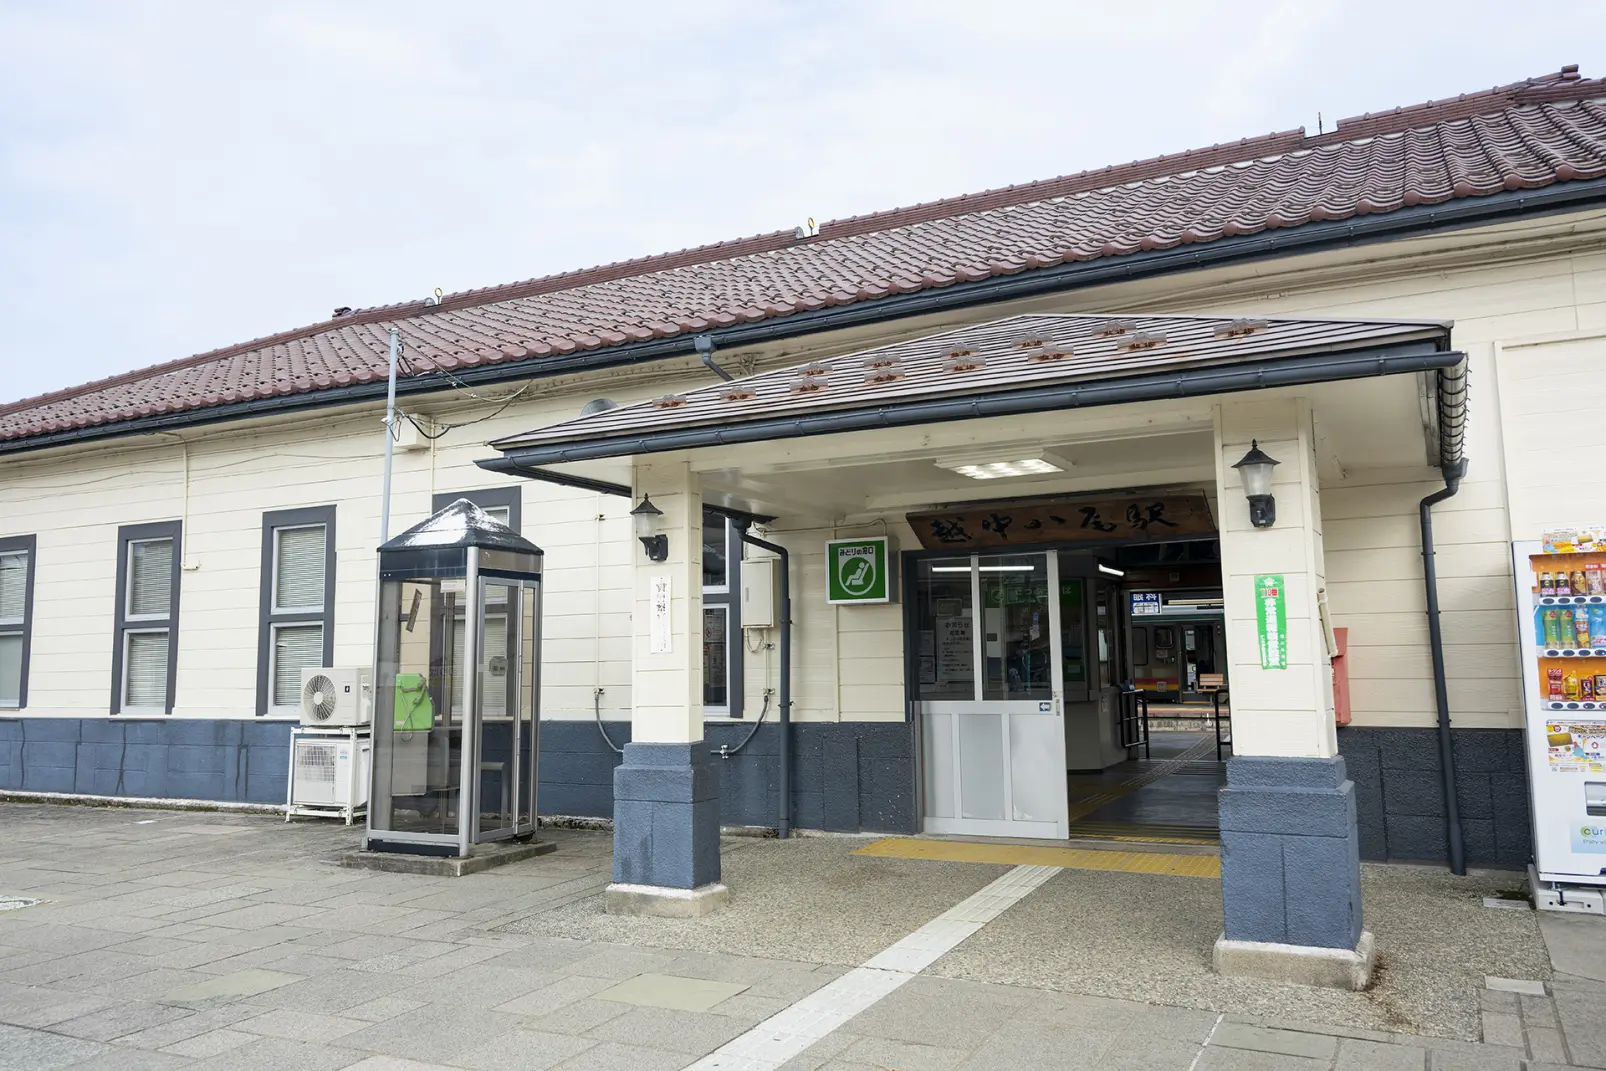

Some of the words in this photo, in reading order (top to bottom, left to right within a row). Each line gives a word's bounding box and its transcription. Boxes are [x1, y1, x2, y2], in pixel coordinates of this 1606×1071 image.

[840, 547, 873, 557] みどりの窓口
